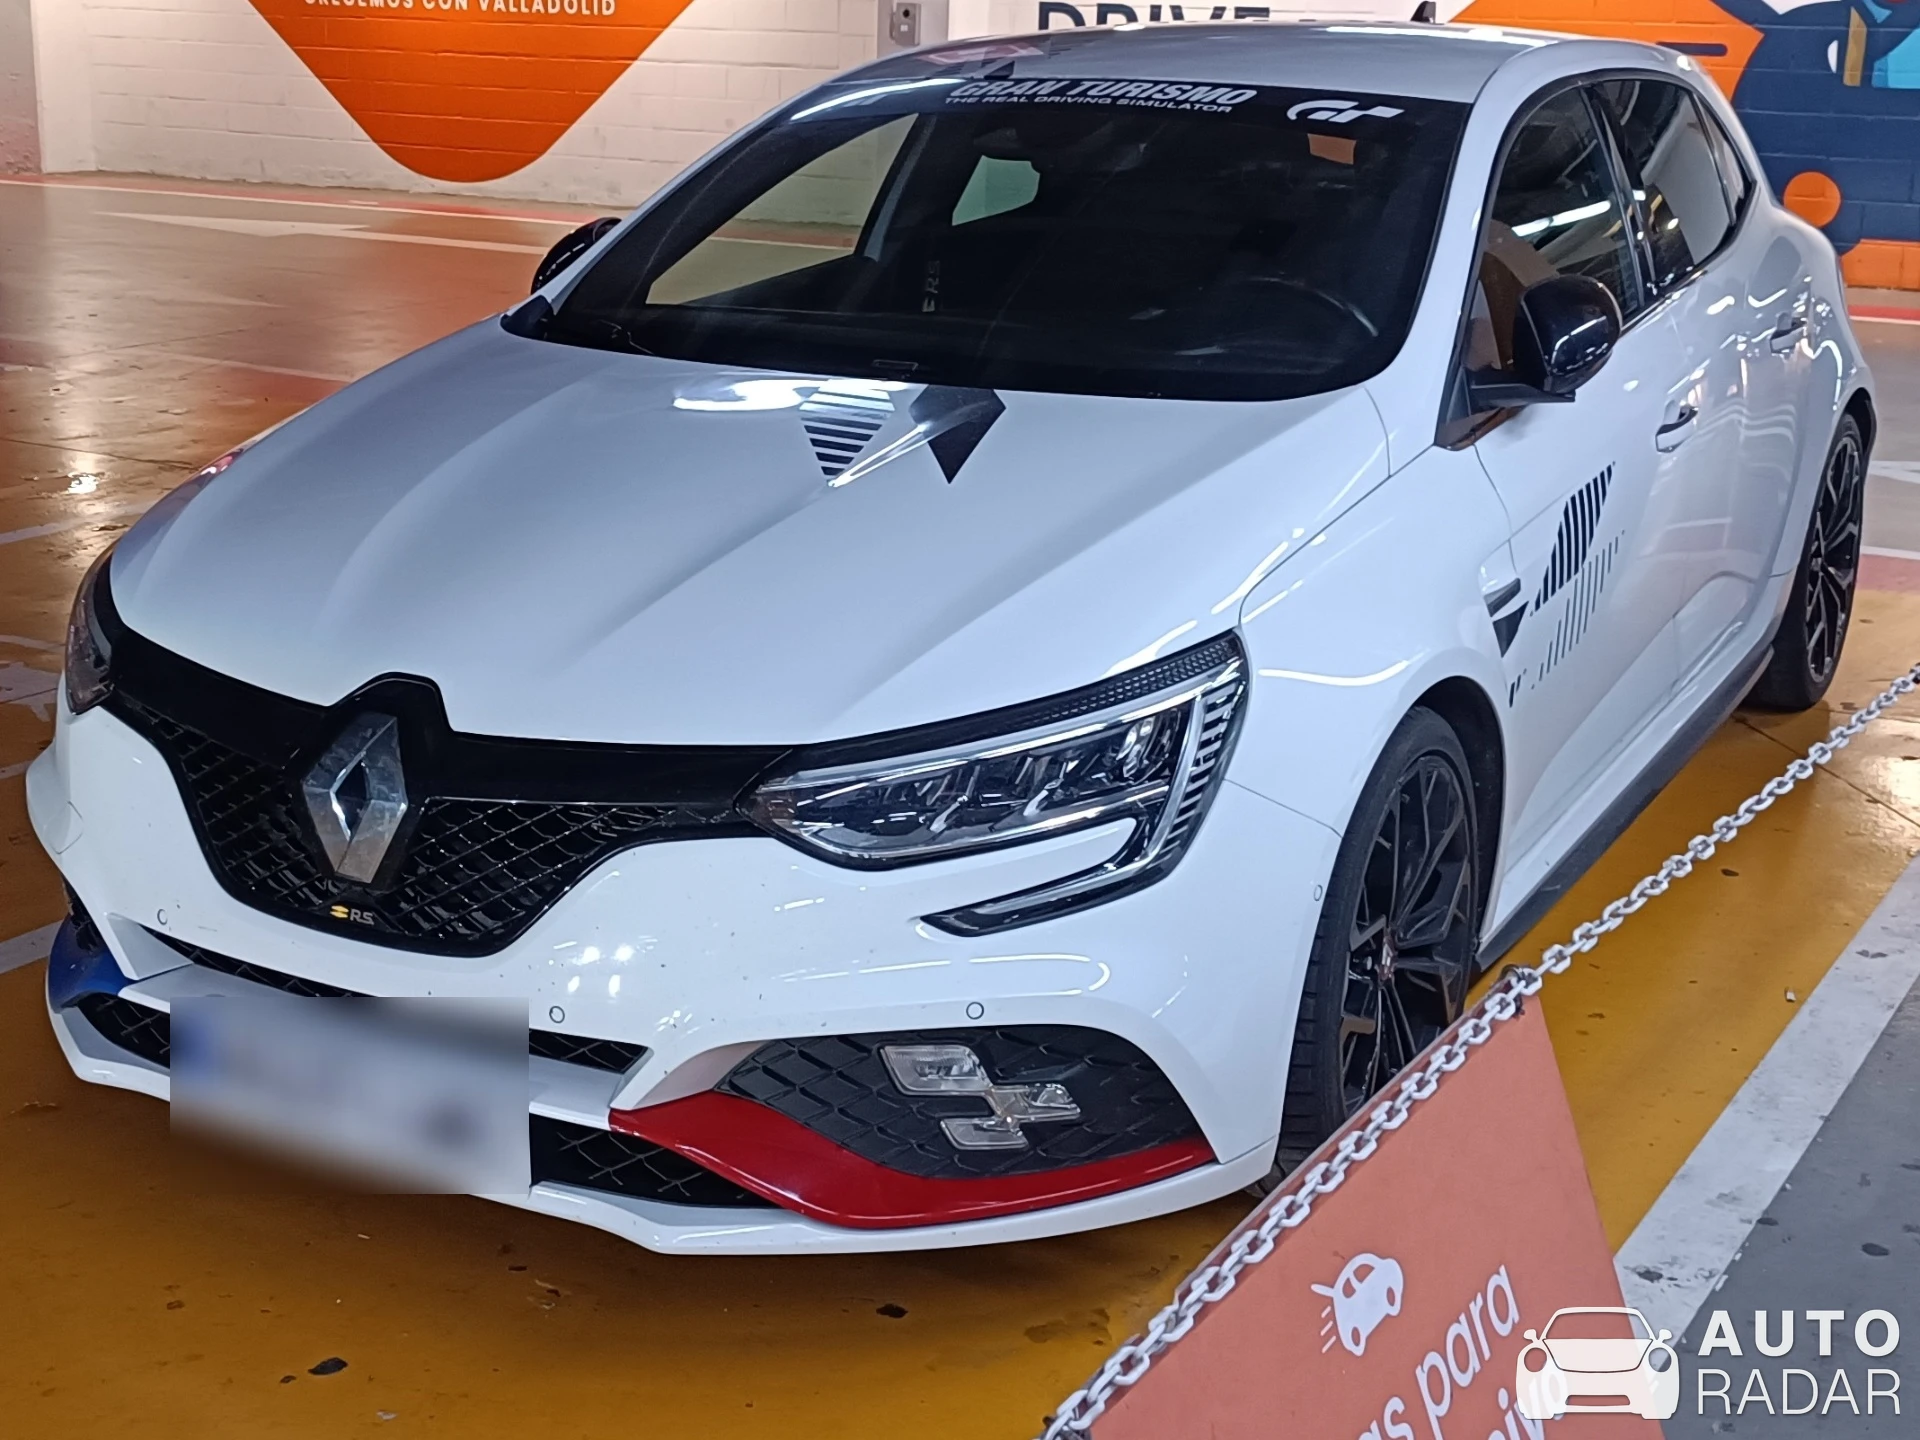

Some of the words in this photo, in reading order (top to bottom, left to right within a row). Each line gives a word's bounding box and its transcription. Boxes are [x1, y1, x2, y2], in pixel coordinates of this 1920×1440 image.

[478, 0, 616, 16] VALLADOLID
[950, 80, 1071, 97] GRAN
[1066, 80, 1258, 105] TURISMO
[1034, 96, 1112, 104] DRIVING
[1116, 98, 1232, 113] SIMULATOR
[350, 908, 375, 925] RS
[1415, 1264, 1520, 1440] para
